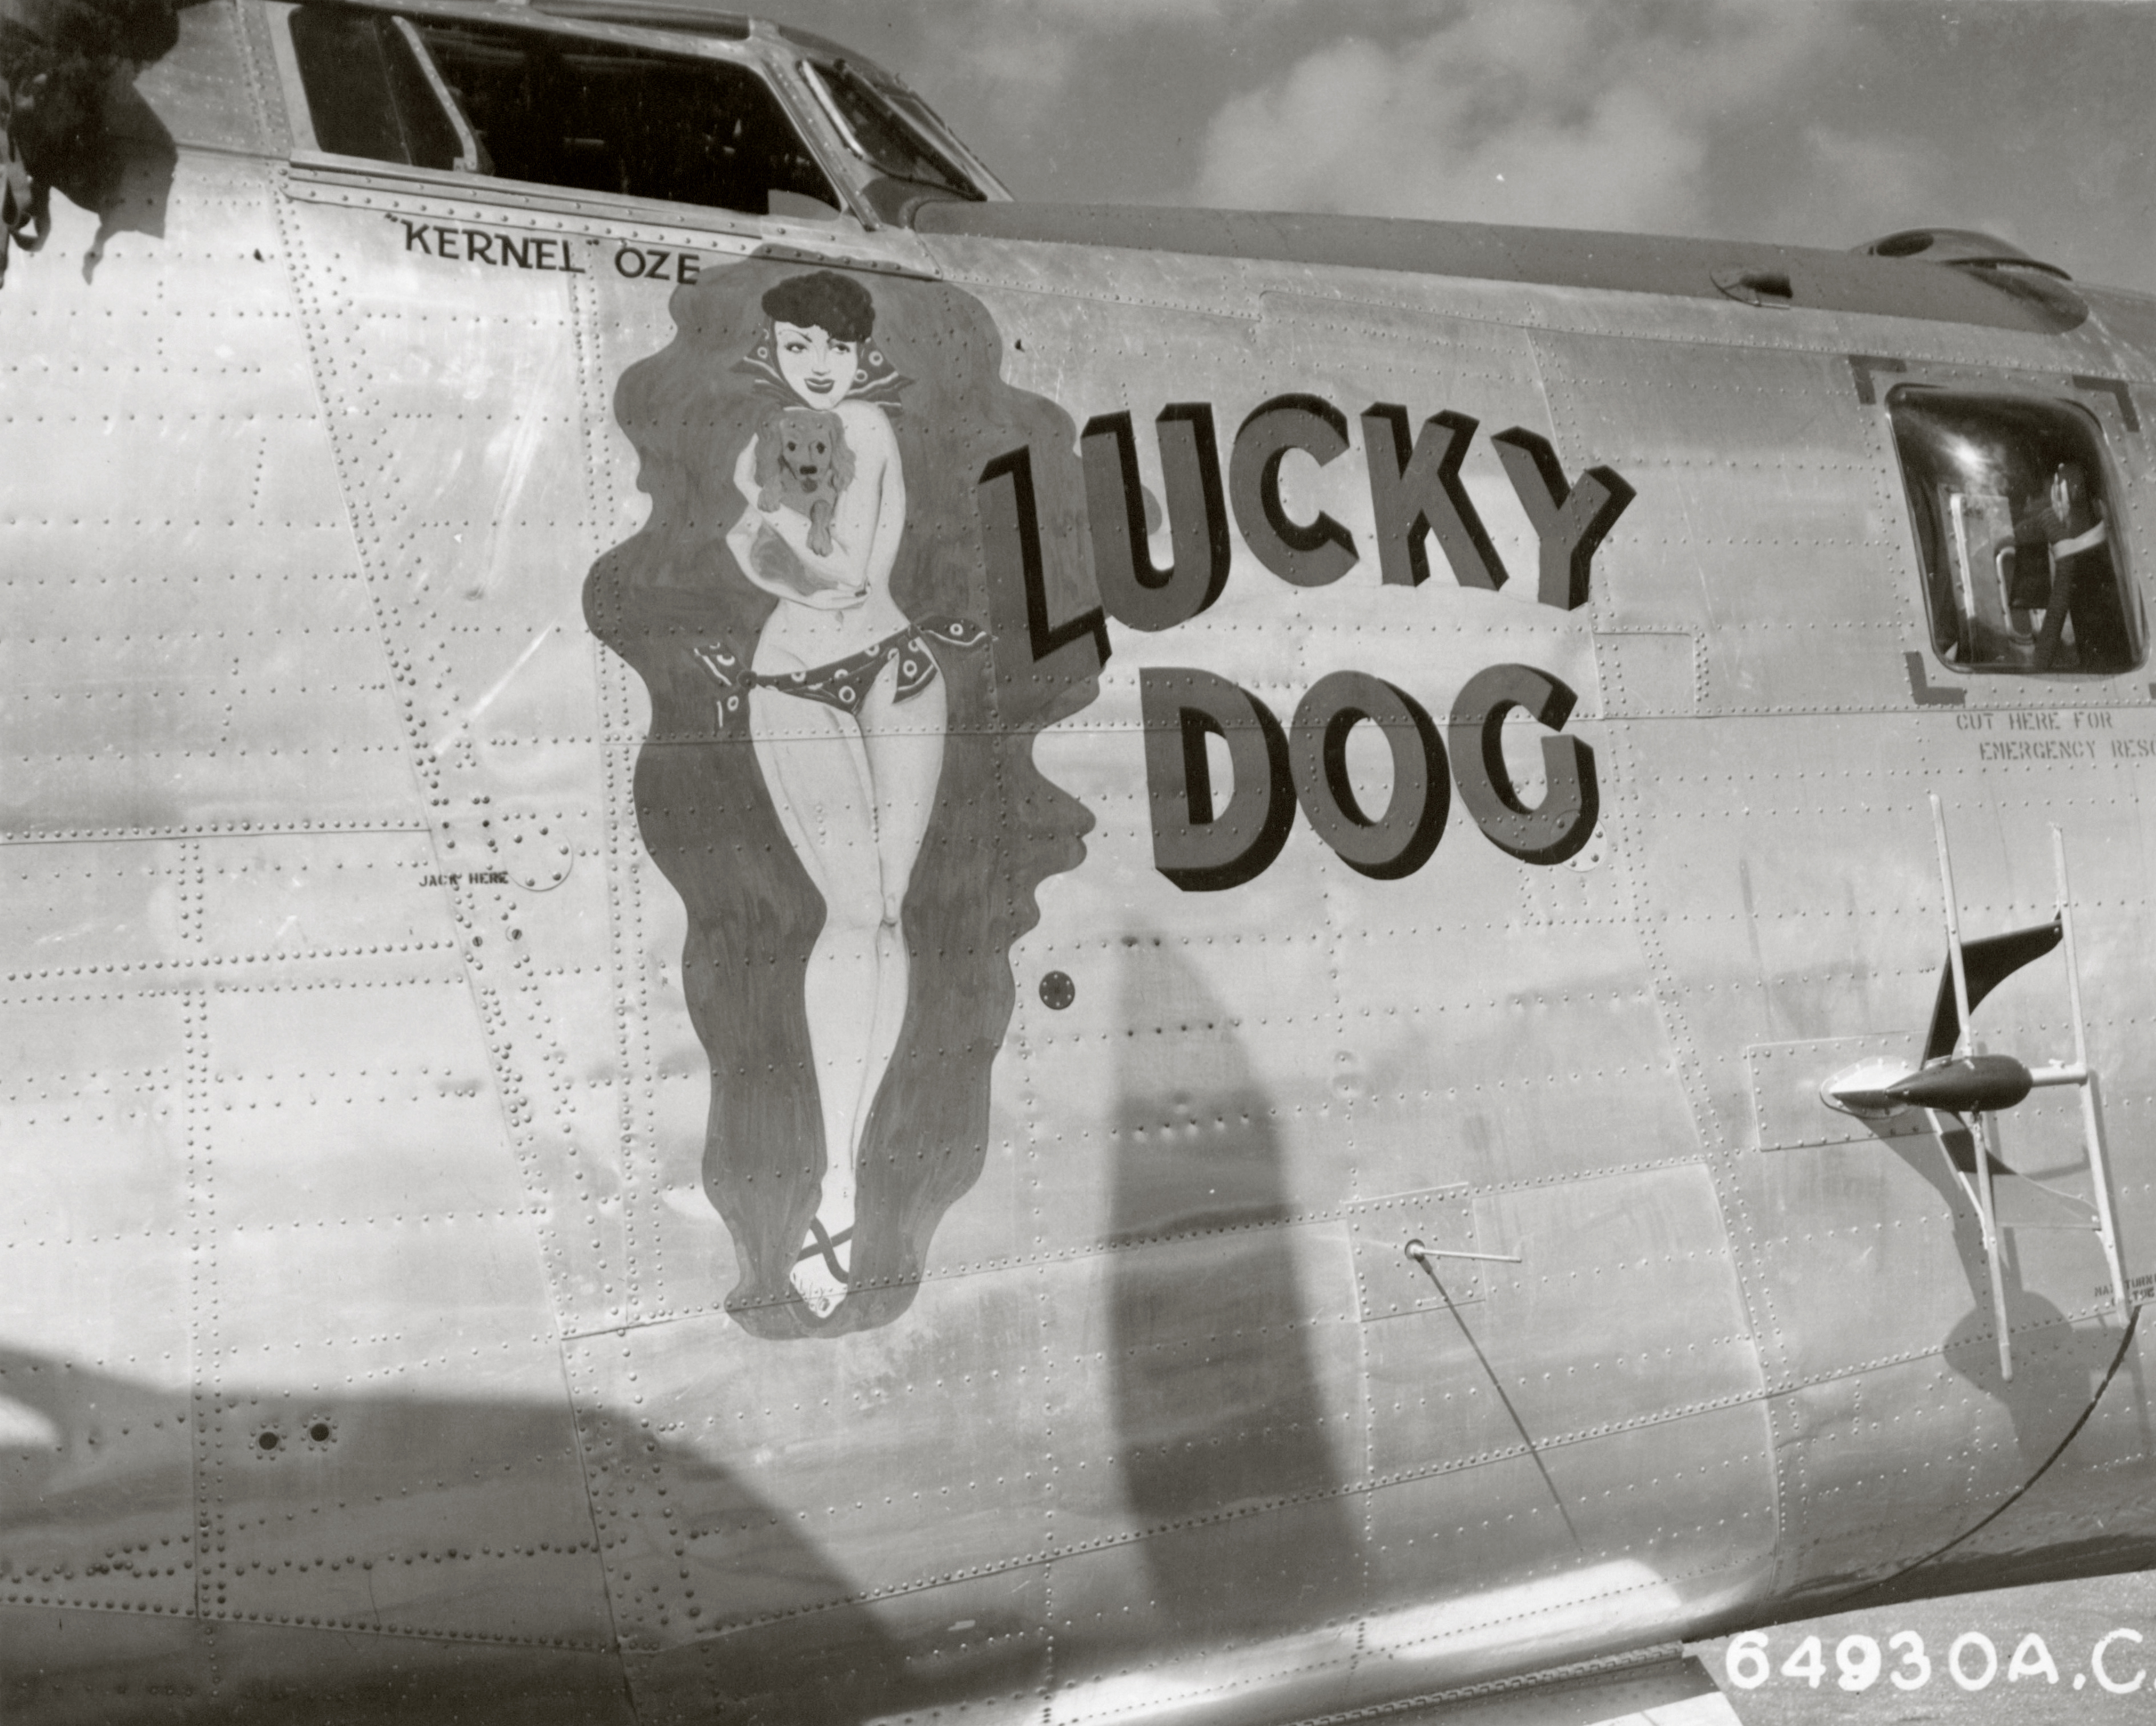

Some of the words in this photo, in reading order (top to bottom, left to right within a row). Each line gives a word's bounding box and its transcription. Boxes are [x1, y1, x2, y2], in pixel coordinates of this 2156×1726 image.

[614, 247, 700, 285] OZE
[978, 392, 1638, 719] LUCKY
[1956, 712, 1994, 730] CUT
[2008, 711, 2061, 730] HERE
[2073, 711, 2113, 729] FOR
[1980, 741, 2096, 761] EMERGENCY
[1139, 662, 1600, 892] DOG
[419, 874, 460, 886] JACK
[468, 871, 509, 884] HERE
[2124, 1273, 2156, 1290] TURN
